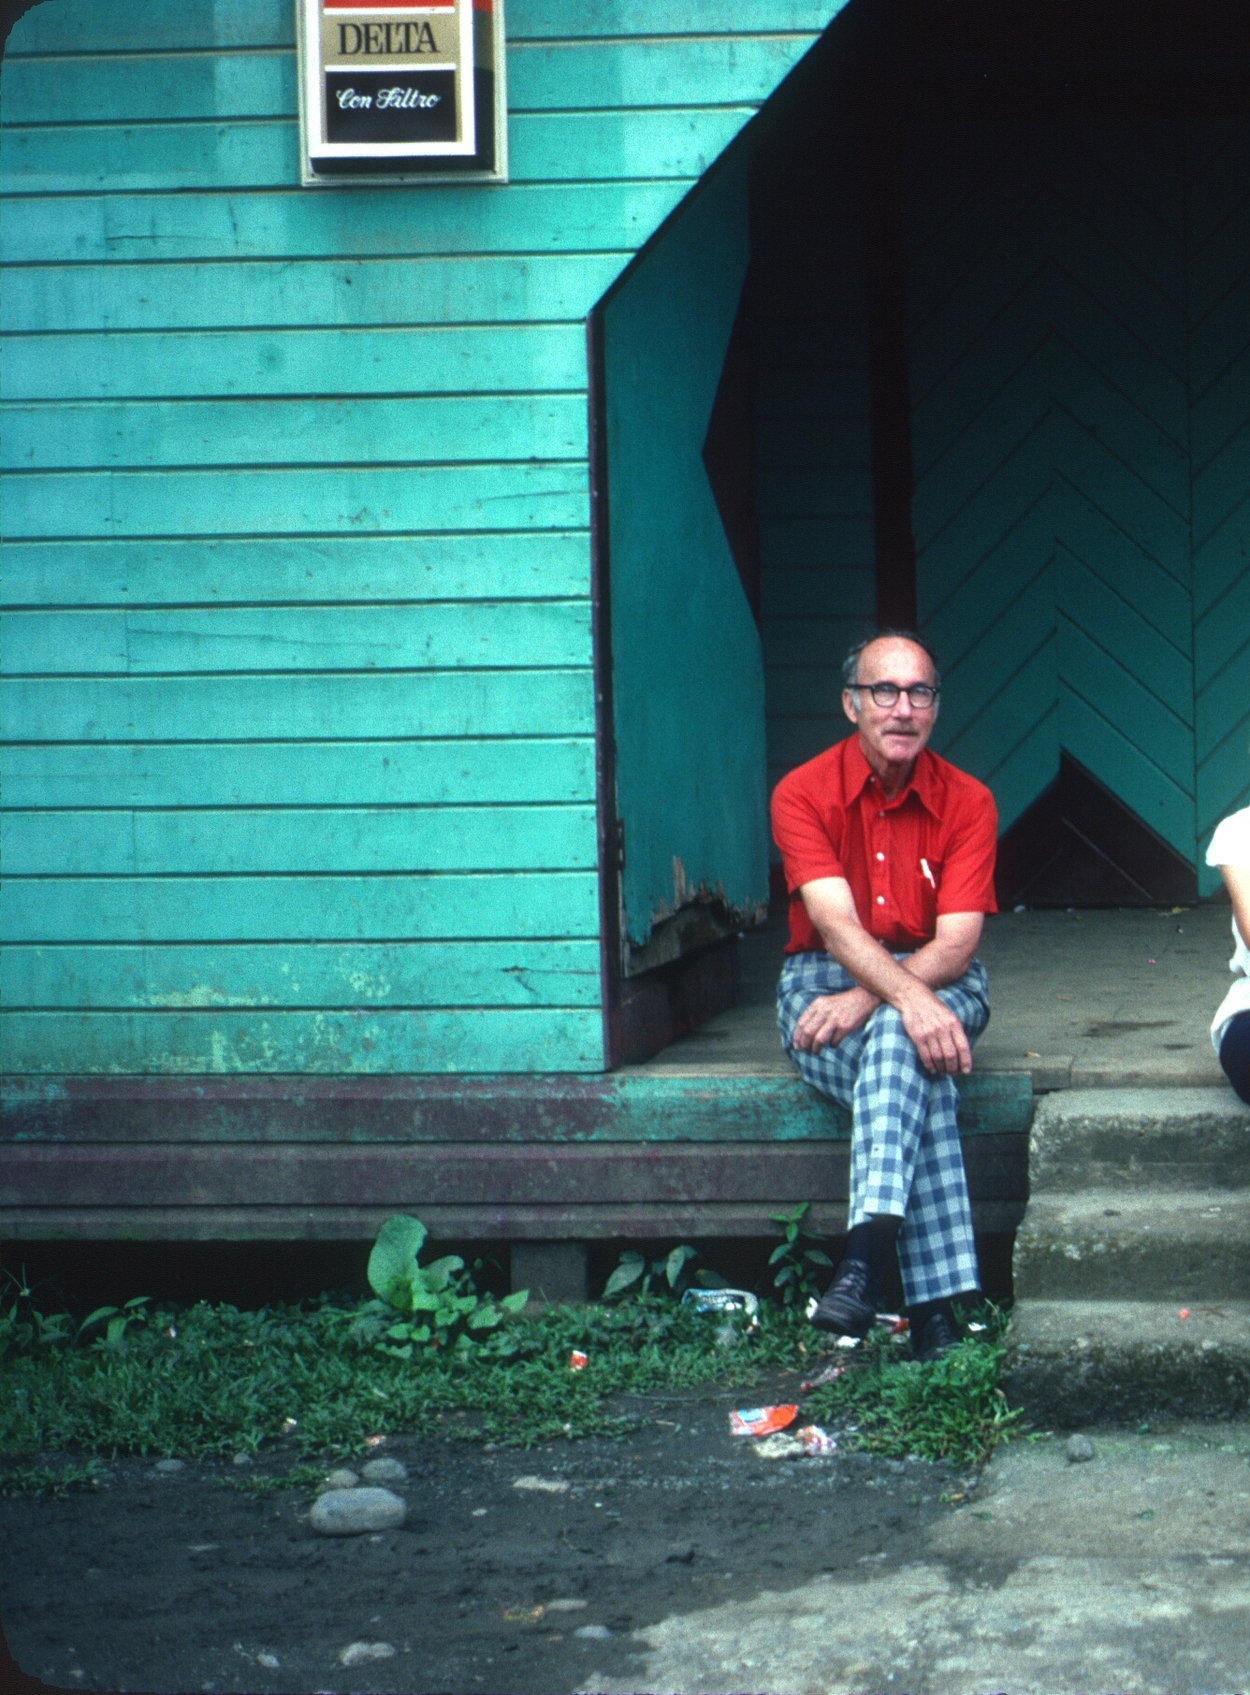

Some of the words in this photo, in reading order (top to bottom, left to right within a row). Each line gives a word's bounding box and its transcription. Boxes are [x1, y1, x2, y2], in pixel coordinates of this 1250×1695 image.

[337, 21, 440, 55] DELTA
[336, 87, 372, 109] Con
[376, 86, 441, 109] Filtro
